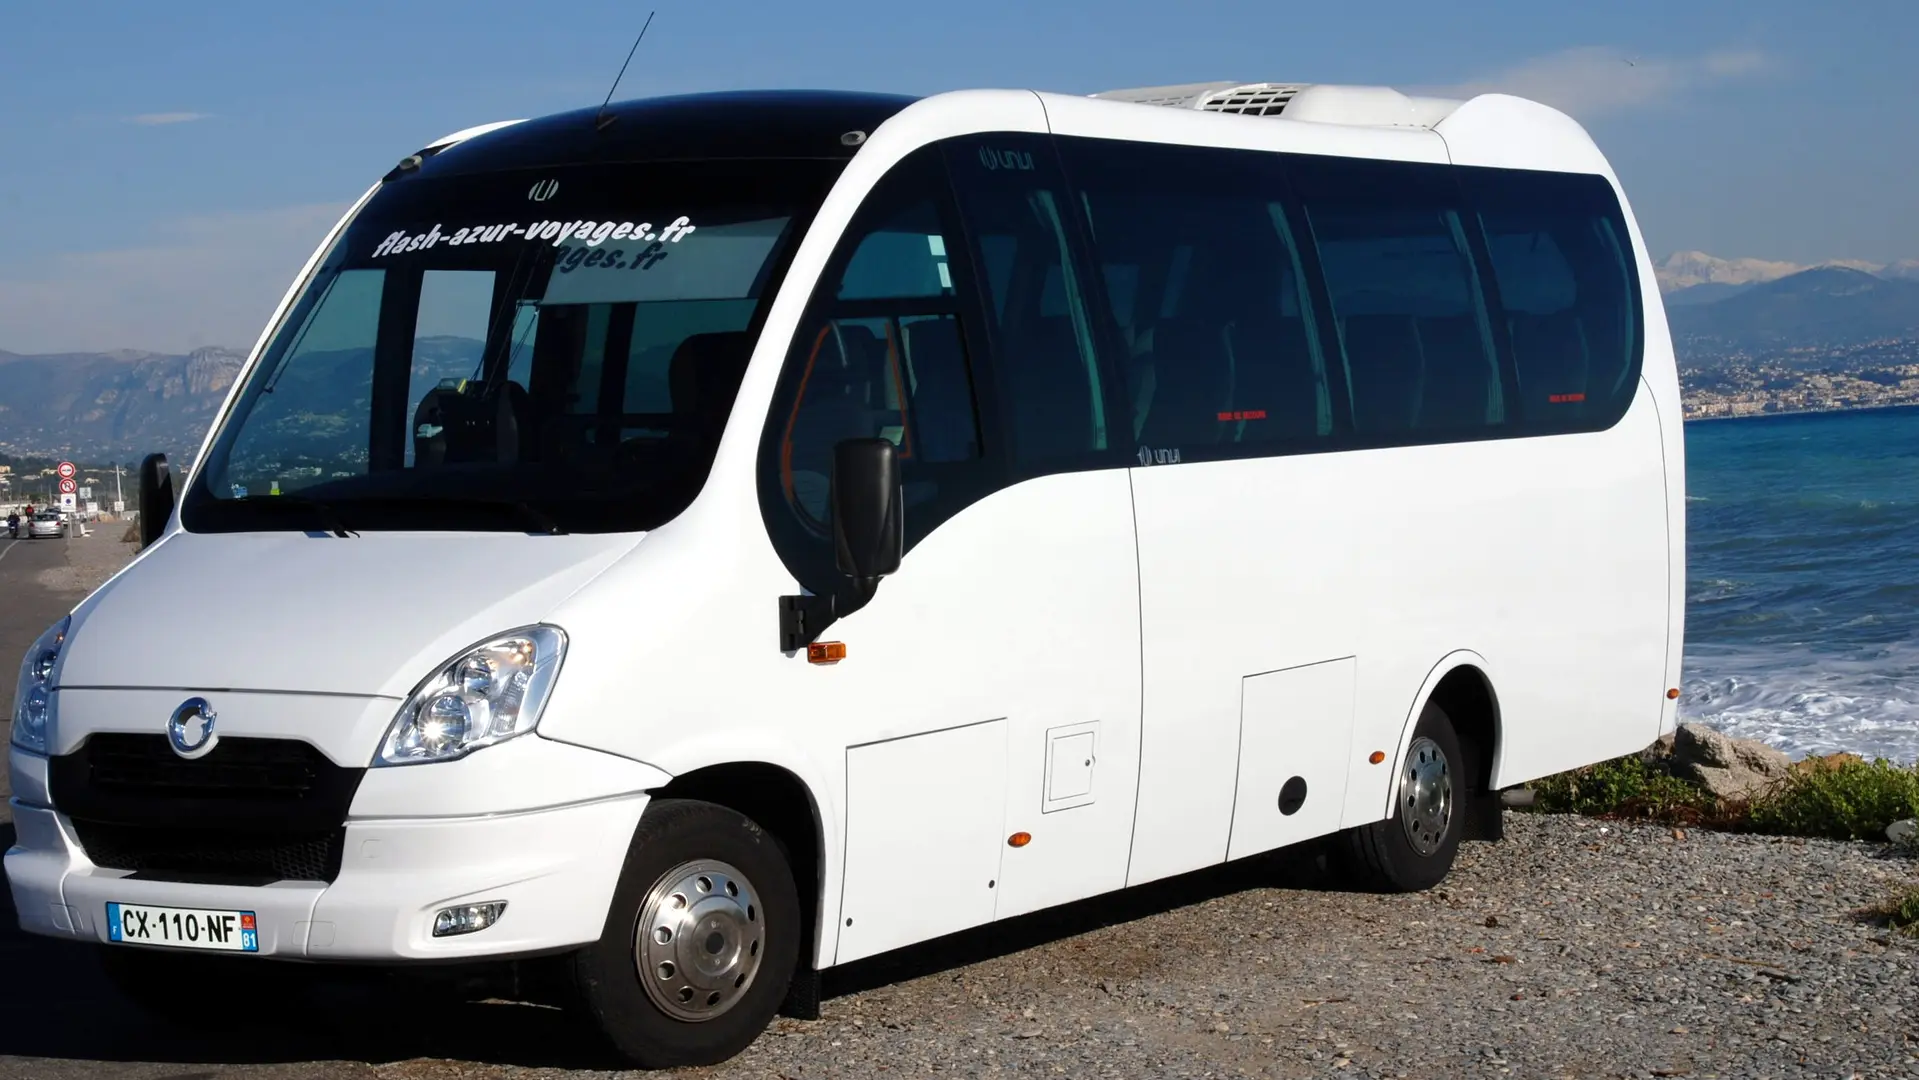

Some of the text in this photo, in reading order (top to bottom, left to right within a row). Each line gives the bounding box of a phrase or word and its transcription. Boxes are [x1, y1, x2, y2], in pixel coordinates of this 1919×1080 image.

[371, 215, 696, 258] flash-azur-voyages.fr
[123, 909, 236, 943] CX-110-NF
[243, 932, 257, 948] 81
